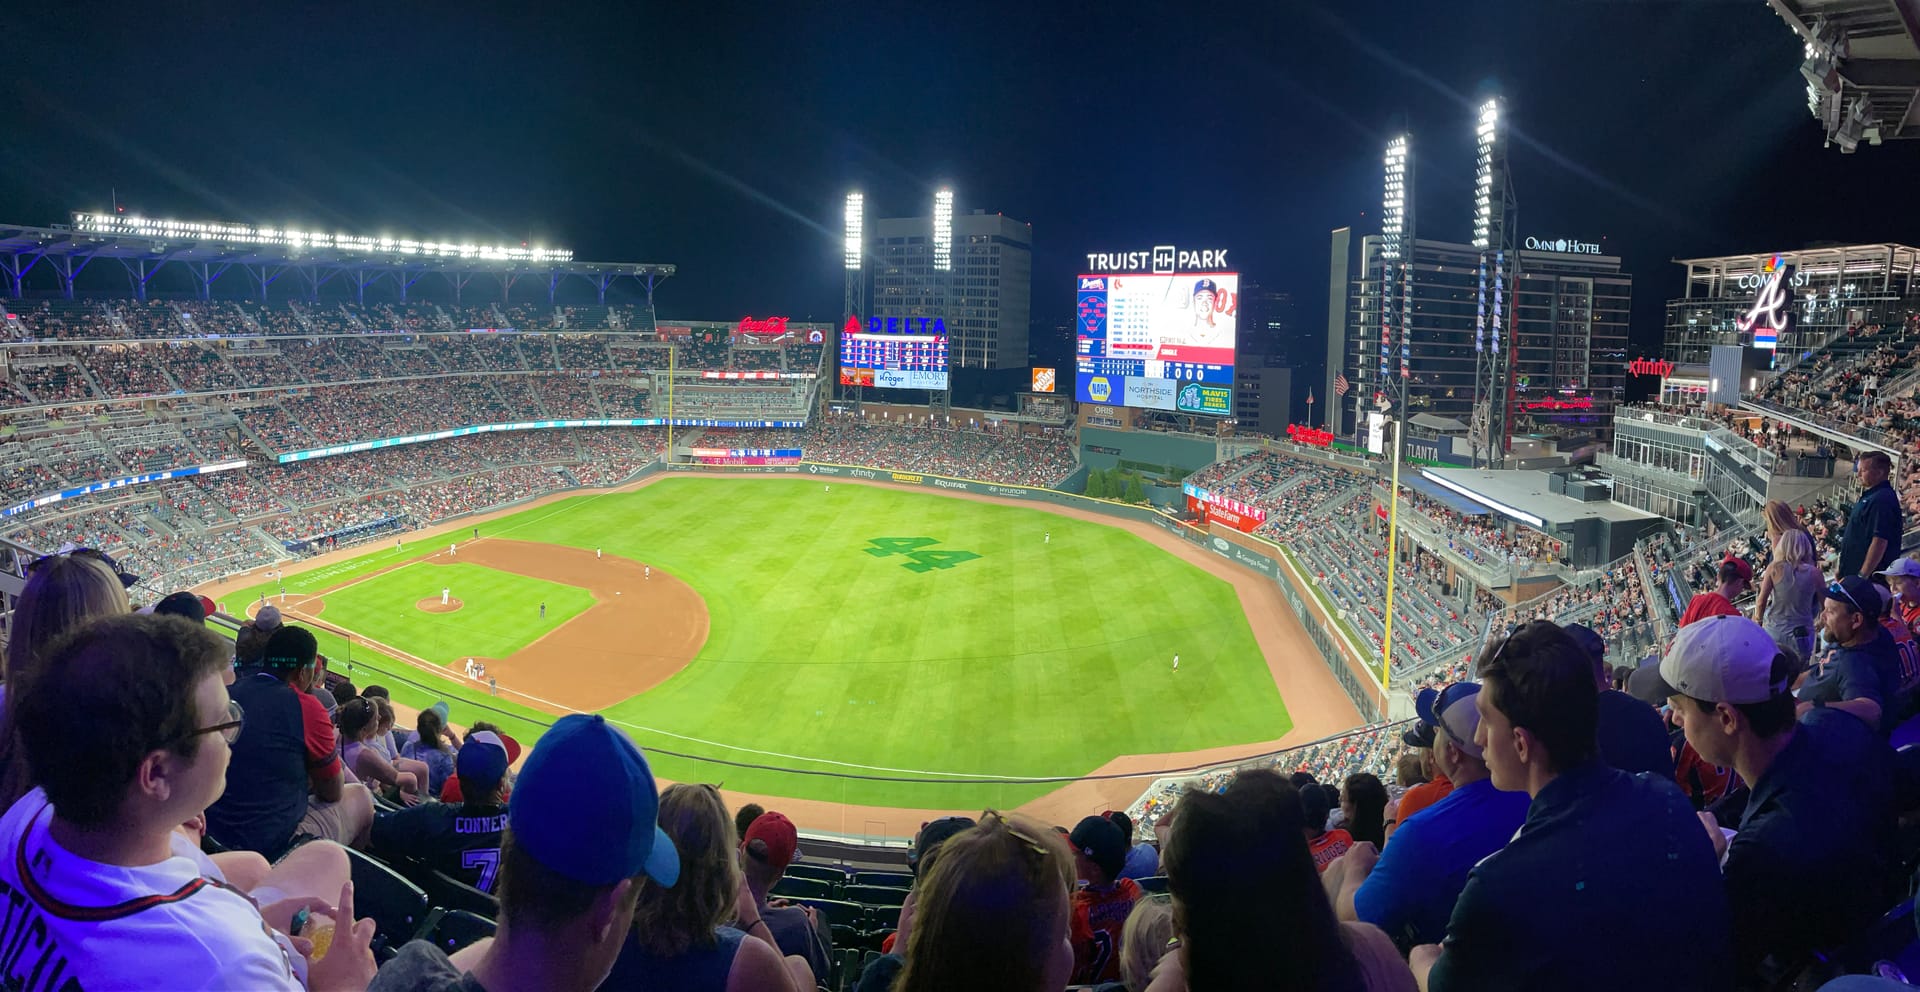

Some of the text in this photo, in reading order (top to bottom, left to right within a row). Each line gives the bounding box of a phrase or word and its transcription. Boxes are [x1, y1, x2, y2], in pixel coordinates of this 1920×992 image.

[1525, 236, 1602, 254] OMNI HOTEL
[1087, 249, 1227, 270] TRUIST PARK
[869, 316, 946, 334] DELTA
[1628, 357, 1674, 379] xfinity
[879, 371, 904, 386] Kroger
[913, 371, 945, 380] EMORY
[1091, 384, 1107, 395] NAPA
[1129, 386, 1173, 395] NORTHSIDE
[1202, 389, 1228, 397] MAVIS
[1094, 407, 1114, 415] ORIS
[850, 468, 876, 480] xfinity
[934, 479, 968, 489] EQUIFAX
[999, 487, 1027, 495] HYUNDAI
[462, 847, 501, 894] 7
